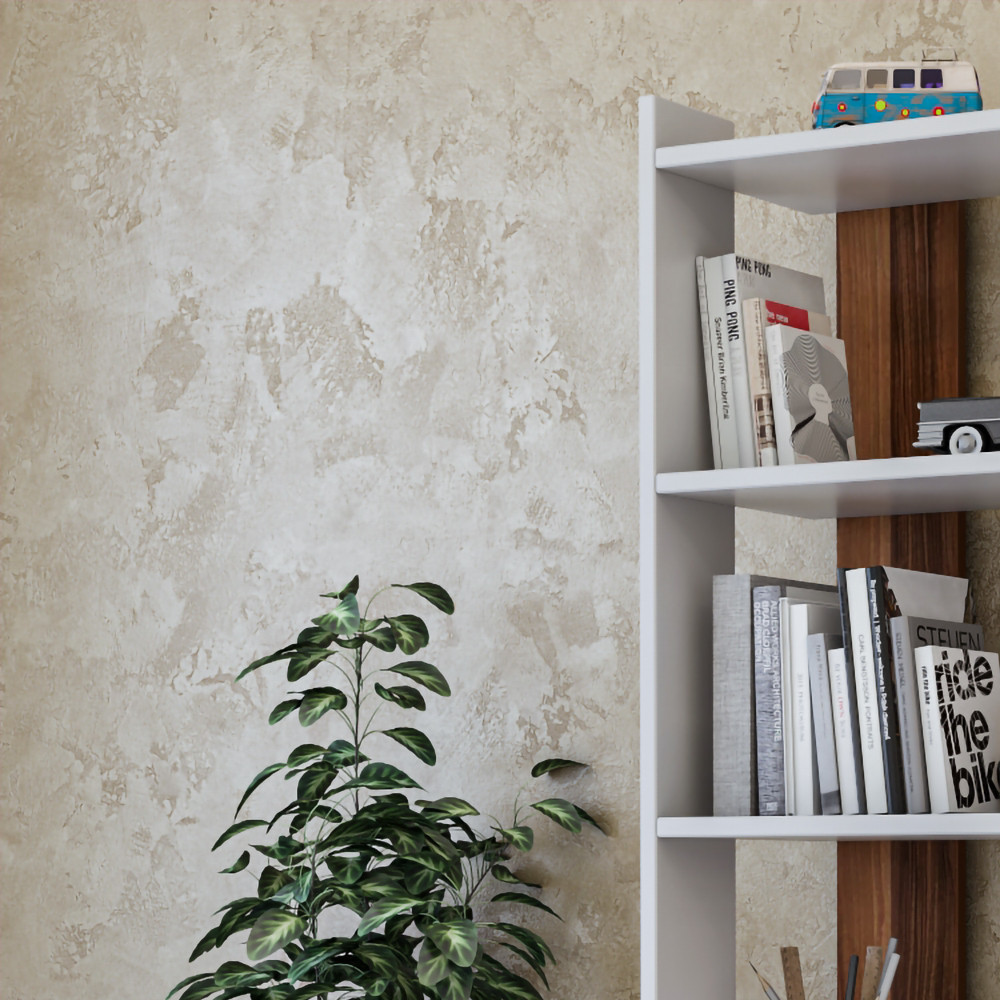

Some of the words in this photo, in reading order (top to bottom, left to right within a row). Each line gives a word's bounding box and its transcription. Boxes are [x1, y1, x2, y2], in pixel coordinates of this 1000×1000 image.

[724, 280, 737, 306] PING
[727, 312, 739, 342] PONG
[762, 601, 770, 626] BRAD
[770, 601, 778, 632] ALLIED
[772, 634, 780, 668] WORKS
[935, 649, 993, 704] ride
[772, 671, 782, 742] ARCHITECTURE
[940, 704, 990, 755] the
